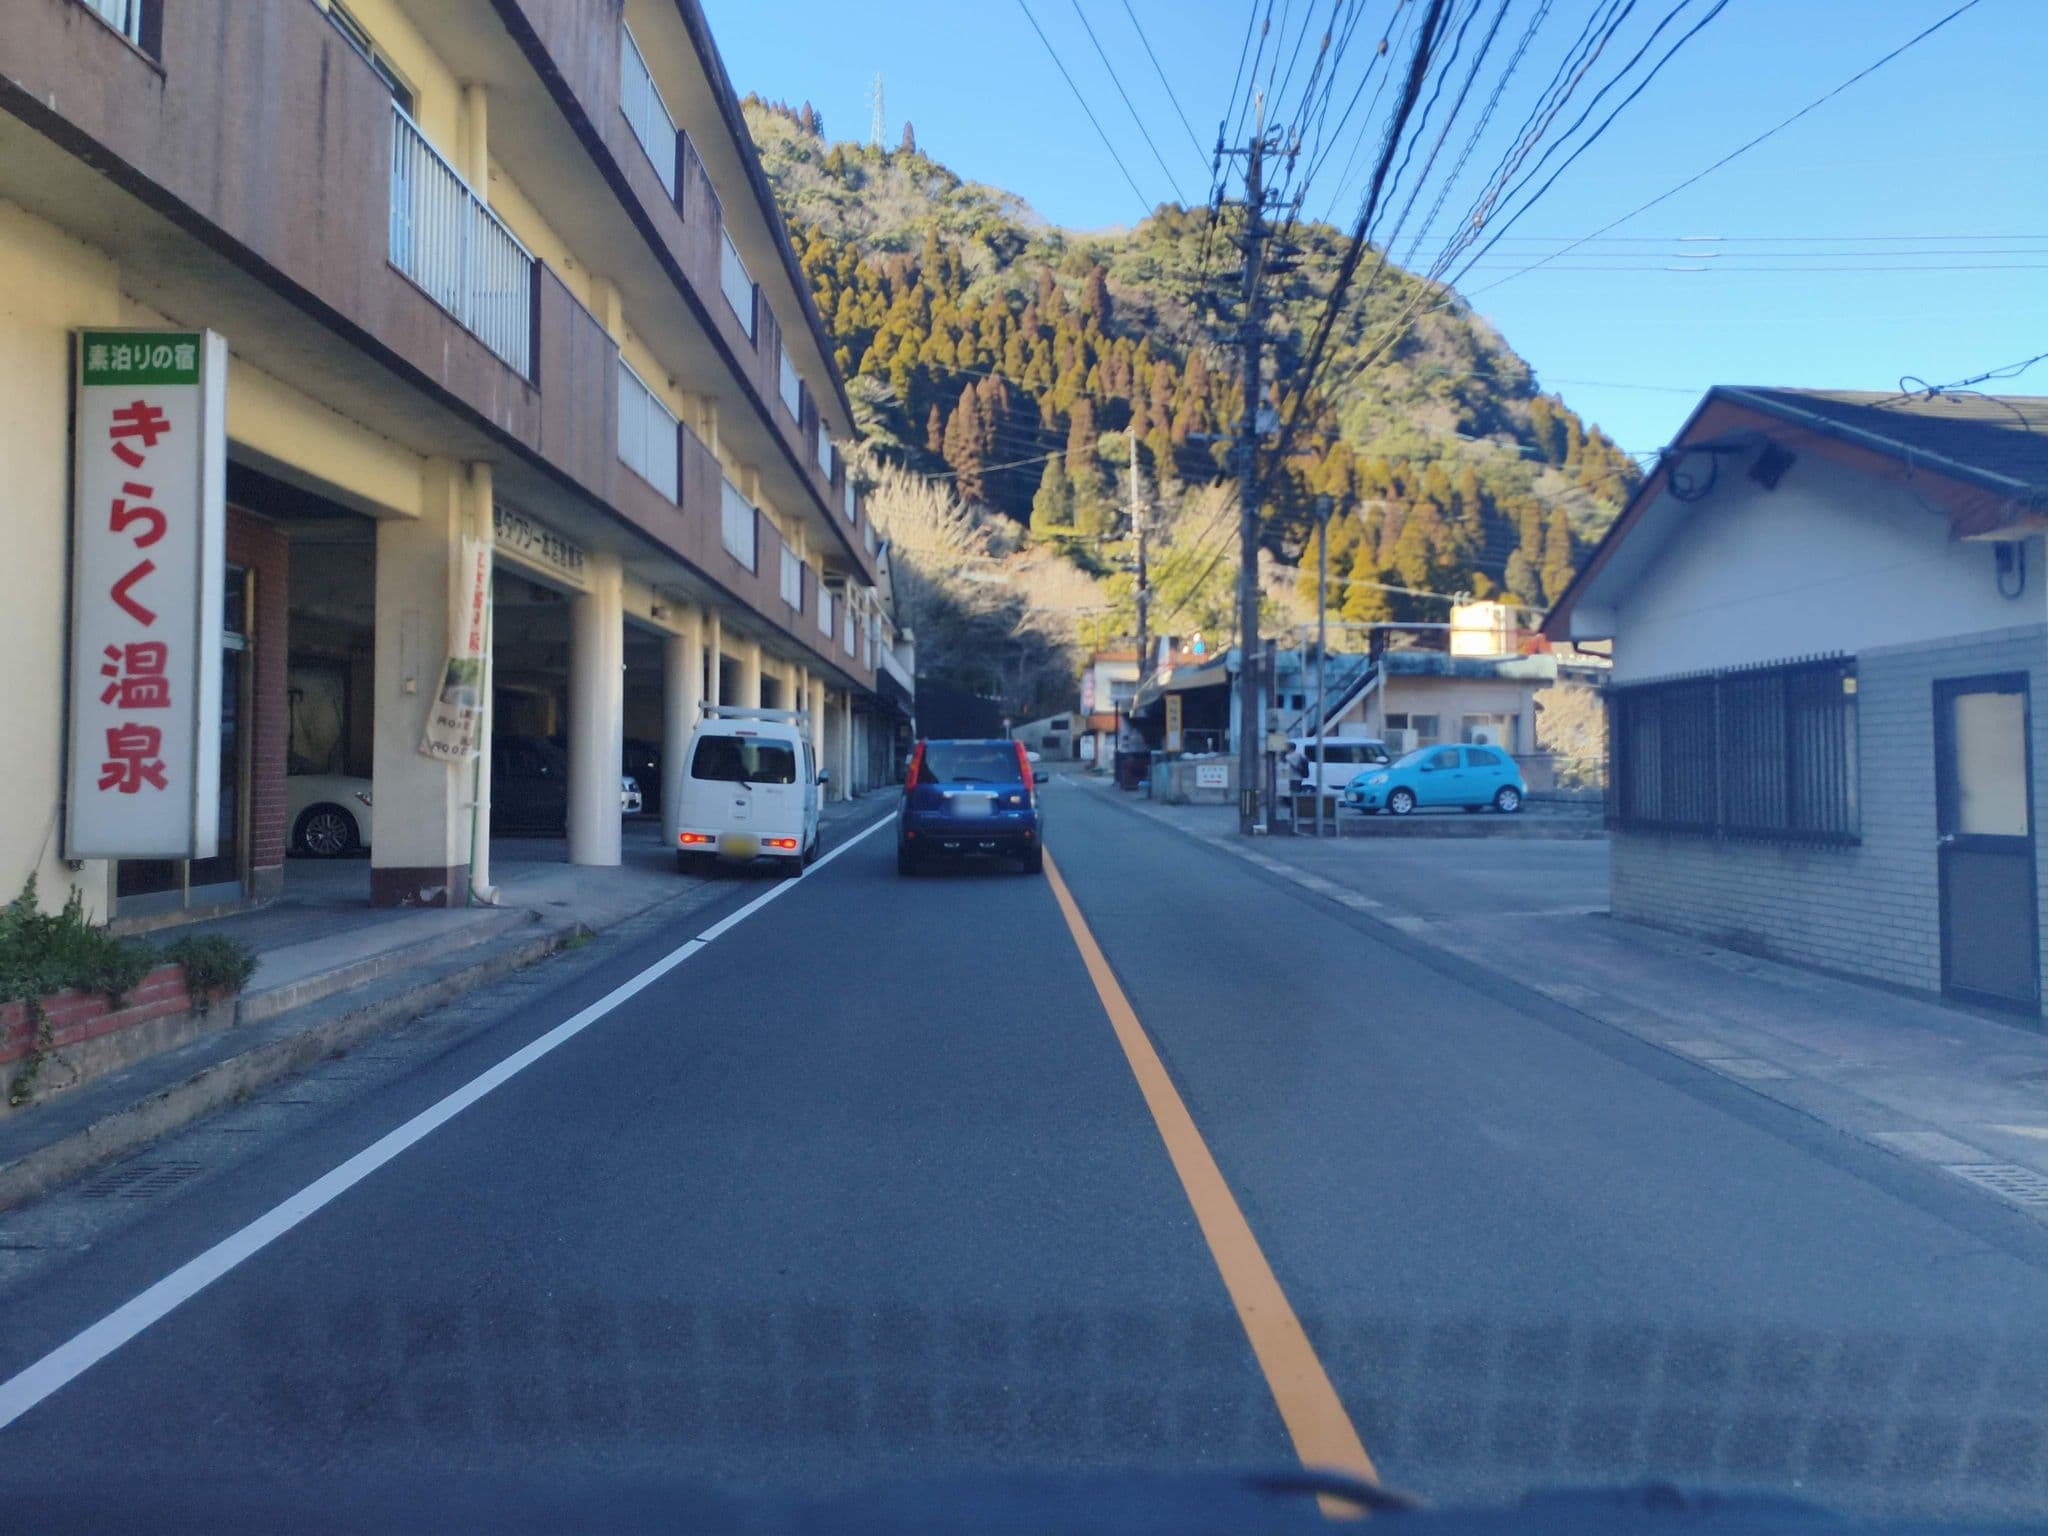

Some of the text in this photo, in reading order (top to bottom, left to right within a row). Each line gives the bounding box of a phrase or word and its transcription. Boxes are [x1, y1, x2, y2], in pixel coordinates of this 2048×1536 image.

[88, 343, 195, 371] 素泊りの宿
[98, 400, 171, 793] きらく温泉
